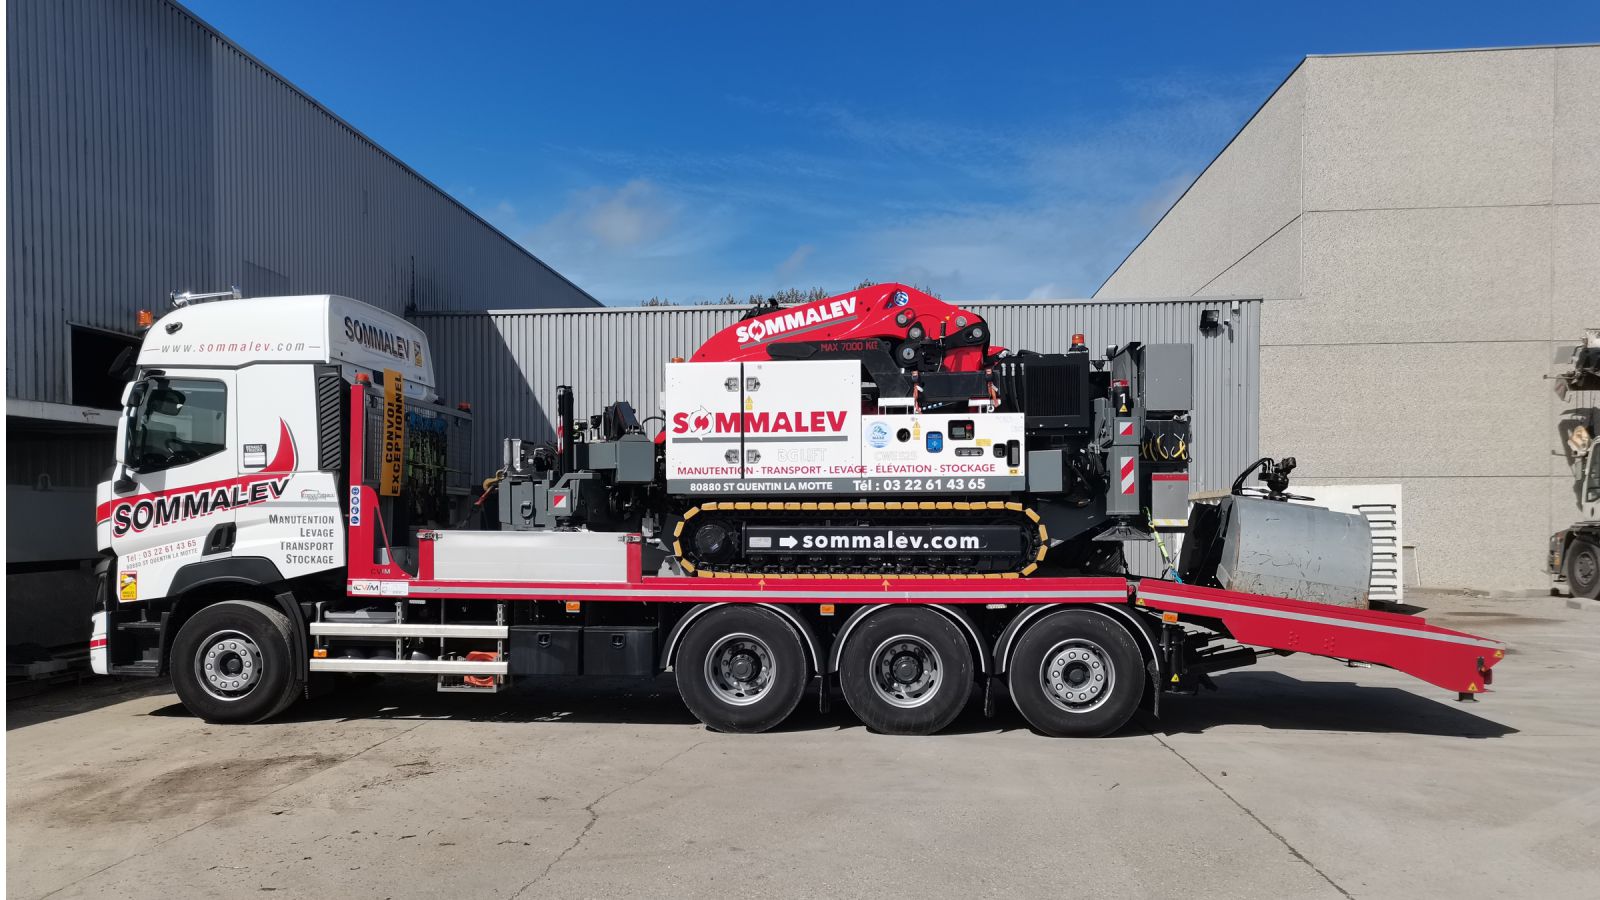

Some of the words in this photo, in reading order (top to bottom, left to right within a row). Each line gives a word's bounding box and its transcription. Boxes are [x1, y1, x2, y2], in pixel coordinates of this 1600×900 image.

[735, 296, 857, 342] SOMMALEV
[344, 316, 410, 361] SOMMALEV
[161, 341, 305, 353] www.sommalev.com
[820, 344, 838, 352] MAX
[841, 342, 863, 351] 7000
[865, 341, 878, 350] KG
[1119, 393, 1126, 404] 1
[672, 408, 848, 437] SOMMALEV
[385, 402, 395, 464] CONVOI
[391, 375, 403, 495] EXCEPTIONNEL
[677, 467, 754, 475] MANUTENTION
[762, 466, 821, 474] TRANSPORT
[829, 465, 868, 474] LEVAGE
[875, 463, 932, 474] ÉLÉVATION
[939, 464, 996, 473] STOCKAGE
[690, 483, 721, 491] 80880
[723, 483, 734, 491] ST
[736, 482, 781, 492] QUENTIN
[783, 482, 796, 491] LA
[798, 482, 833, 490] MOTTE
[853, 480, 872, 491] Tél
[883, 480, 900, 491] 03
[904, 480, 922, 491] 22
[925, 479, 943, 490] 61
[946, 479, 965, 490] 43
[967, 479, 986, 490] 65
[113, 478, 290, 537] SOMMALEV
[268, 514, 335, 525] MANUTENTION
[300, 527, 334, 538] LEVAGE
[802, 530, 980, 549] sommalev.com
[142, 550, 152, 559] 03
[154, 547, 163, 556] 22
[165, 545, 174, 553] 61
[176, 542, 186, 550] 43
[187, 539, 197, 547] 65
[280, 541, 334, 551] TRANSPORT
[150, 555, 172, 564] QUENTIN
[180, 548, 198, 556] MOTTE
[286, 554, 334, 564] STOCKAGE
